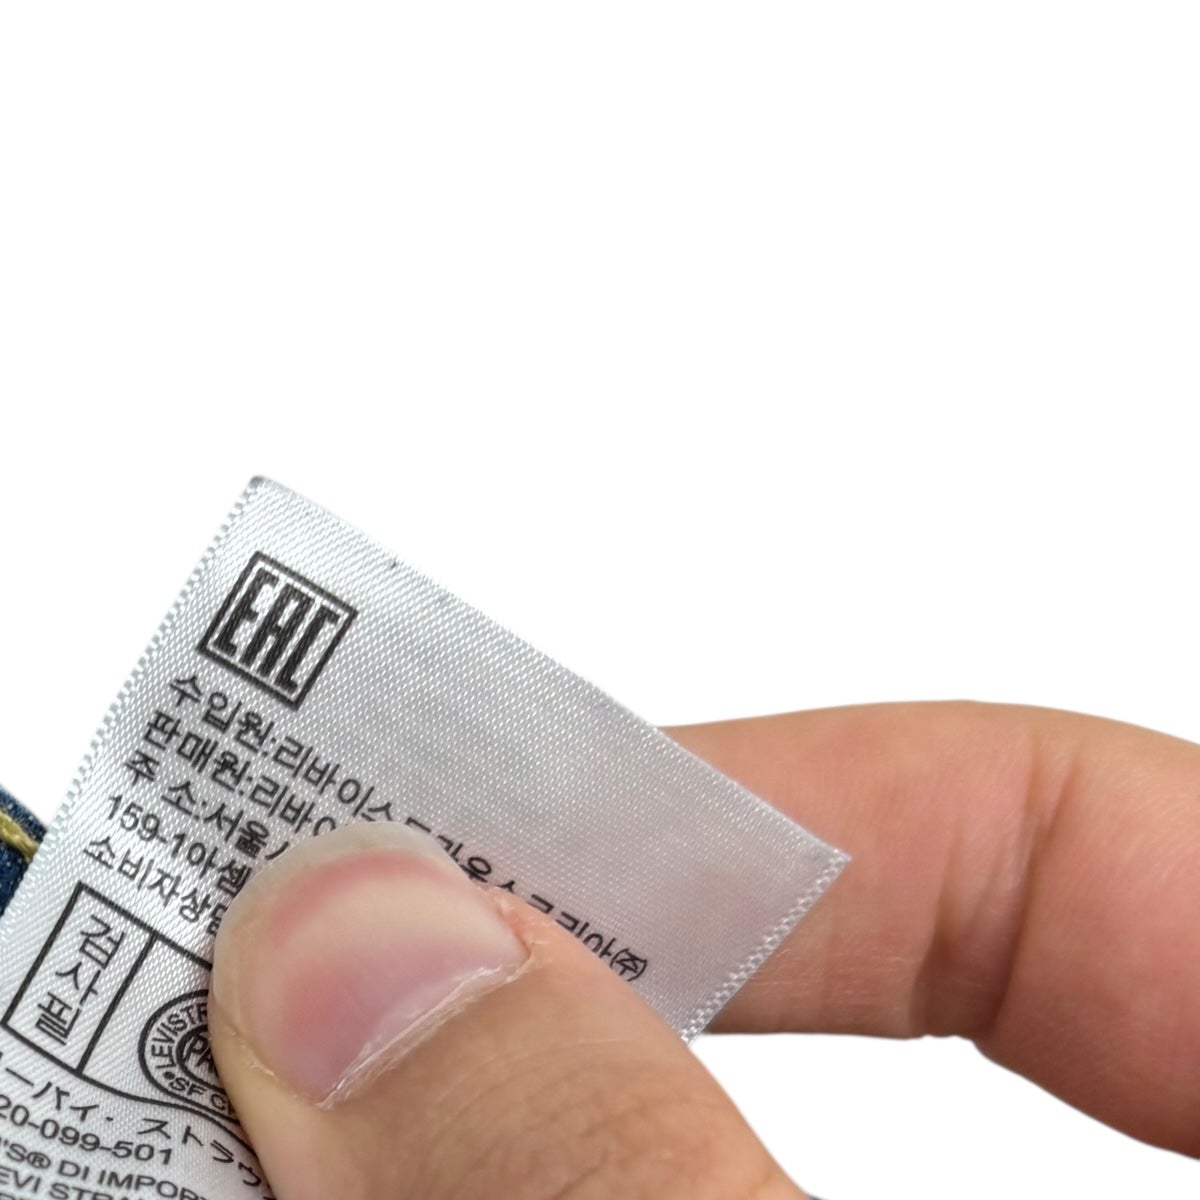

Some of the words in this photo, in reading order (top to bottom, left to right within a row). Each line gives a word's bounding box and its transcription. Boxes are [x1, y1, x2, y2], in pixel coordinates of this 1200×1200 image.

[212, 566, 342, 695] EAC
[123, 749, 160, 785] 주
[160, 780, 289, 862] 소:서울
[57, 1159, 89, 1181] DI
